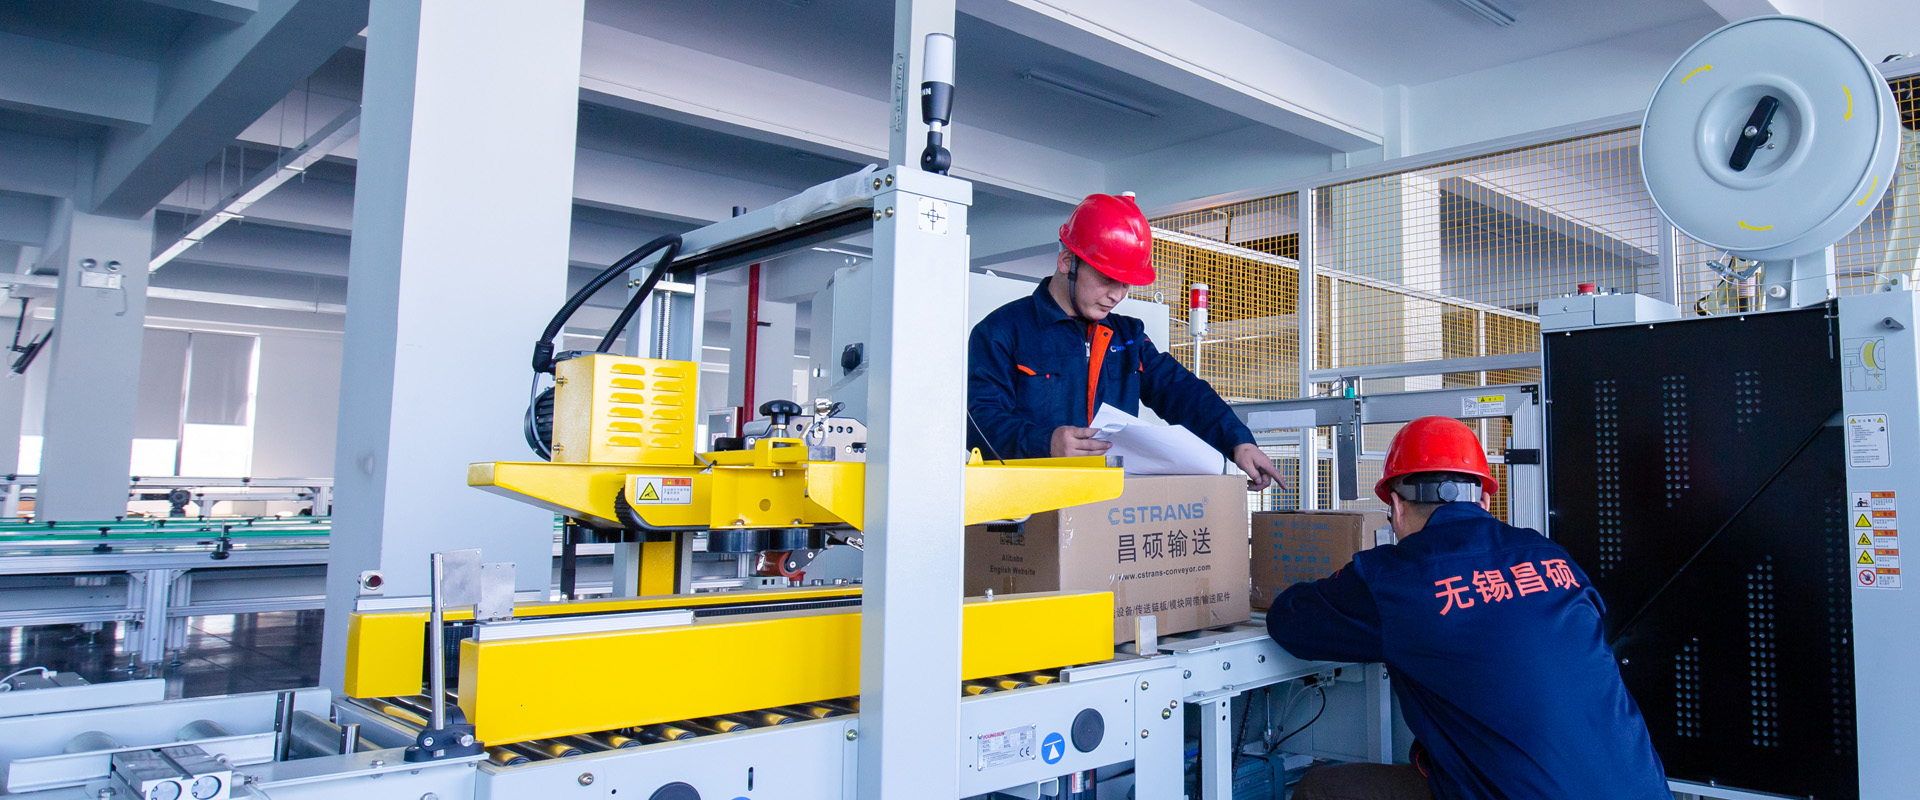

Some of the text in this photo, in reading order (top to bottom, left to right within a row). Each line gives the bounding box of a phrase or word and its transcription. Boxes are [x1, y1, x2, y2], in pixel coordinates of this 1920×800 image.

[1117, 526, 1212, 564] 昌硕输送
[1001, 554, 1024, 562] Alibaba
[989, 565, 1036, 576] English Website
[1118, 564, 1212, 581] www.cstrans-conveyor.com
[1434, 558, 1581, 616] 无锡昌硕
[1113, 591, 1231, 619] 设备/传送链板/模块网带/输送配件
